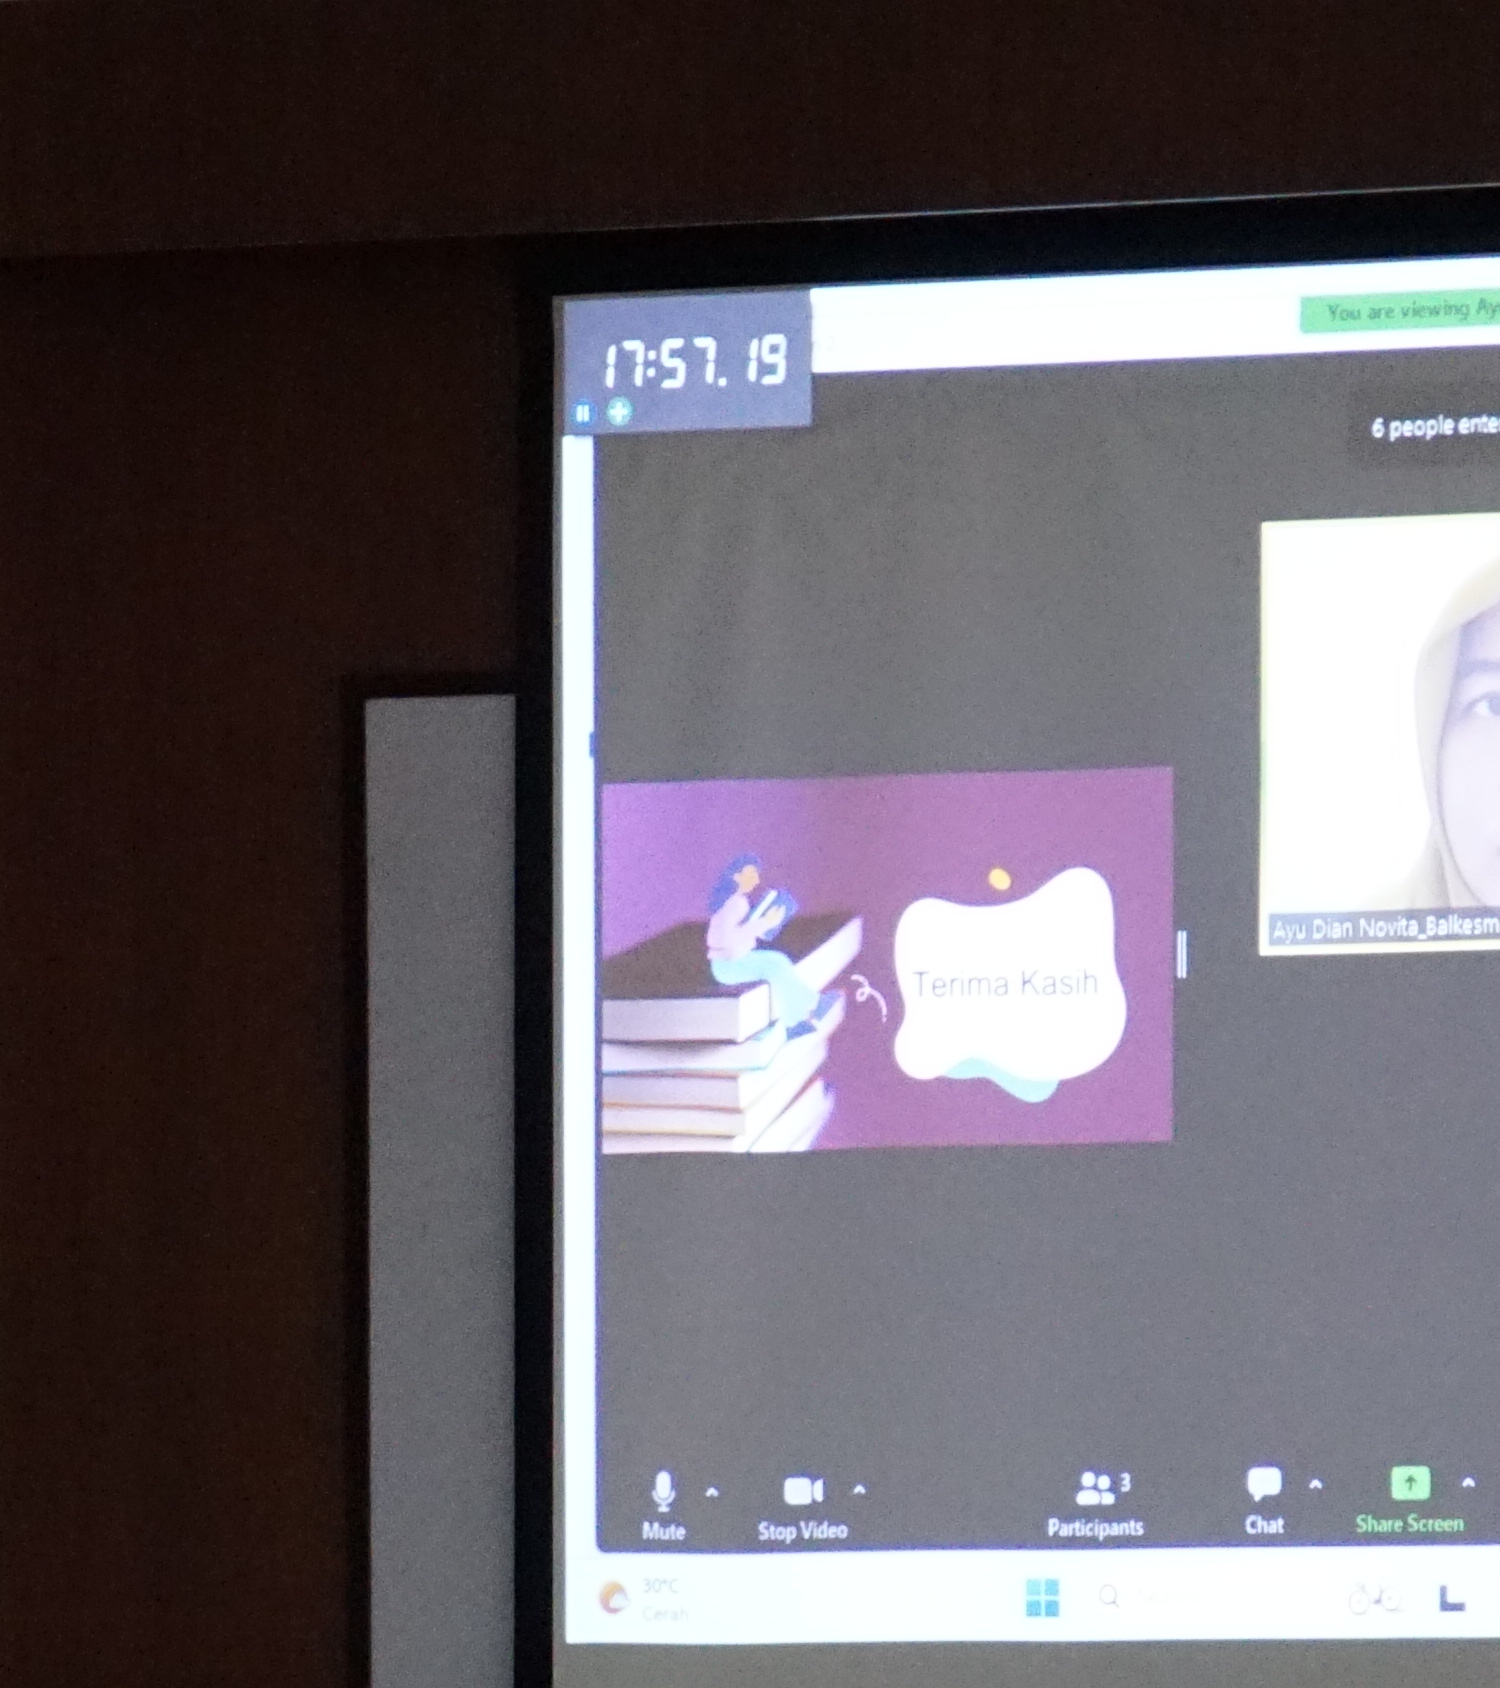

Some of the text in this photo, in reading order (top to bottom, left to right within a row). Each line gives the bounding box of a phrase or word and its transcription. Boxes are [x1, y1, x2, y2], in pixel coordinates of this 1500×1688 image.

[1327, 301, 1361, 322] You
[1368, 305, 1395, 320] are
[1400, 299, 1470, 322] viewing
[1371, 417, 1385, 438] 6
[1388, 414, 1455, 441] people
[1271, 919, 1307, 944] Ayu
[1311, 917, 1353, 939] Dian
[912, 968, 1100, 998] Terima Kasih
[1119, 1472, 1132, 1493] 3
[641, 1521, 687, 1541] Mute
[757, 1520, 849, 1542] Stop Video
[1047, 1517, 1145, 1542] Participants
[1244, 1514, 1285, 1535] Chat
[1355, 1513, 1465, 1534] Share Screen
